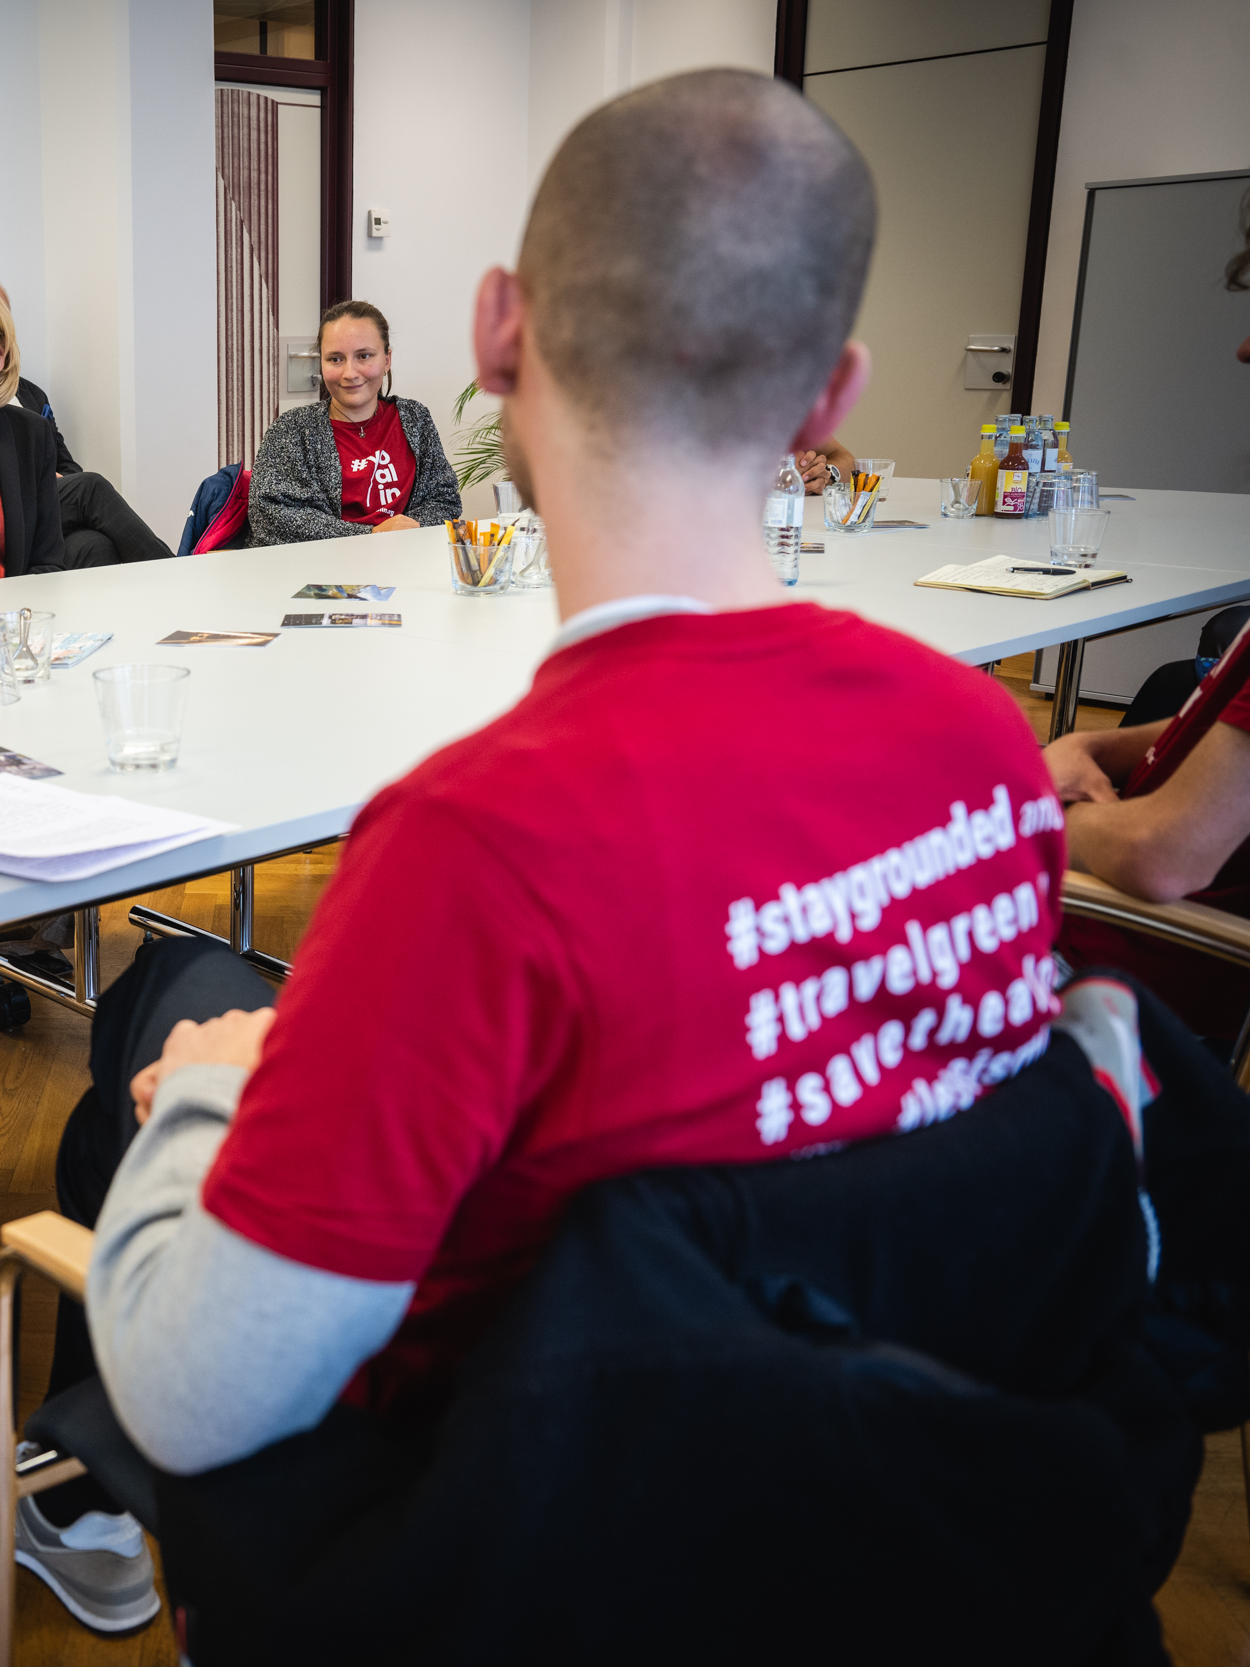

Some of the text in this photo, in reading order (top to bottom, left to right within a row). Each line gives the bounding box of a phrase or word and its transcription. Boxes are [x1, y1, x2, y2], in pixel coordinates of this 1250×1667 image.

[375, 463, 399, 484] al
[378, 484, 401, 506] in
[725, 783, 1016, 969] #staygrounded
[745, 881, 1038, 1060] #travelgreen
